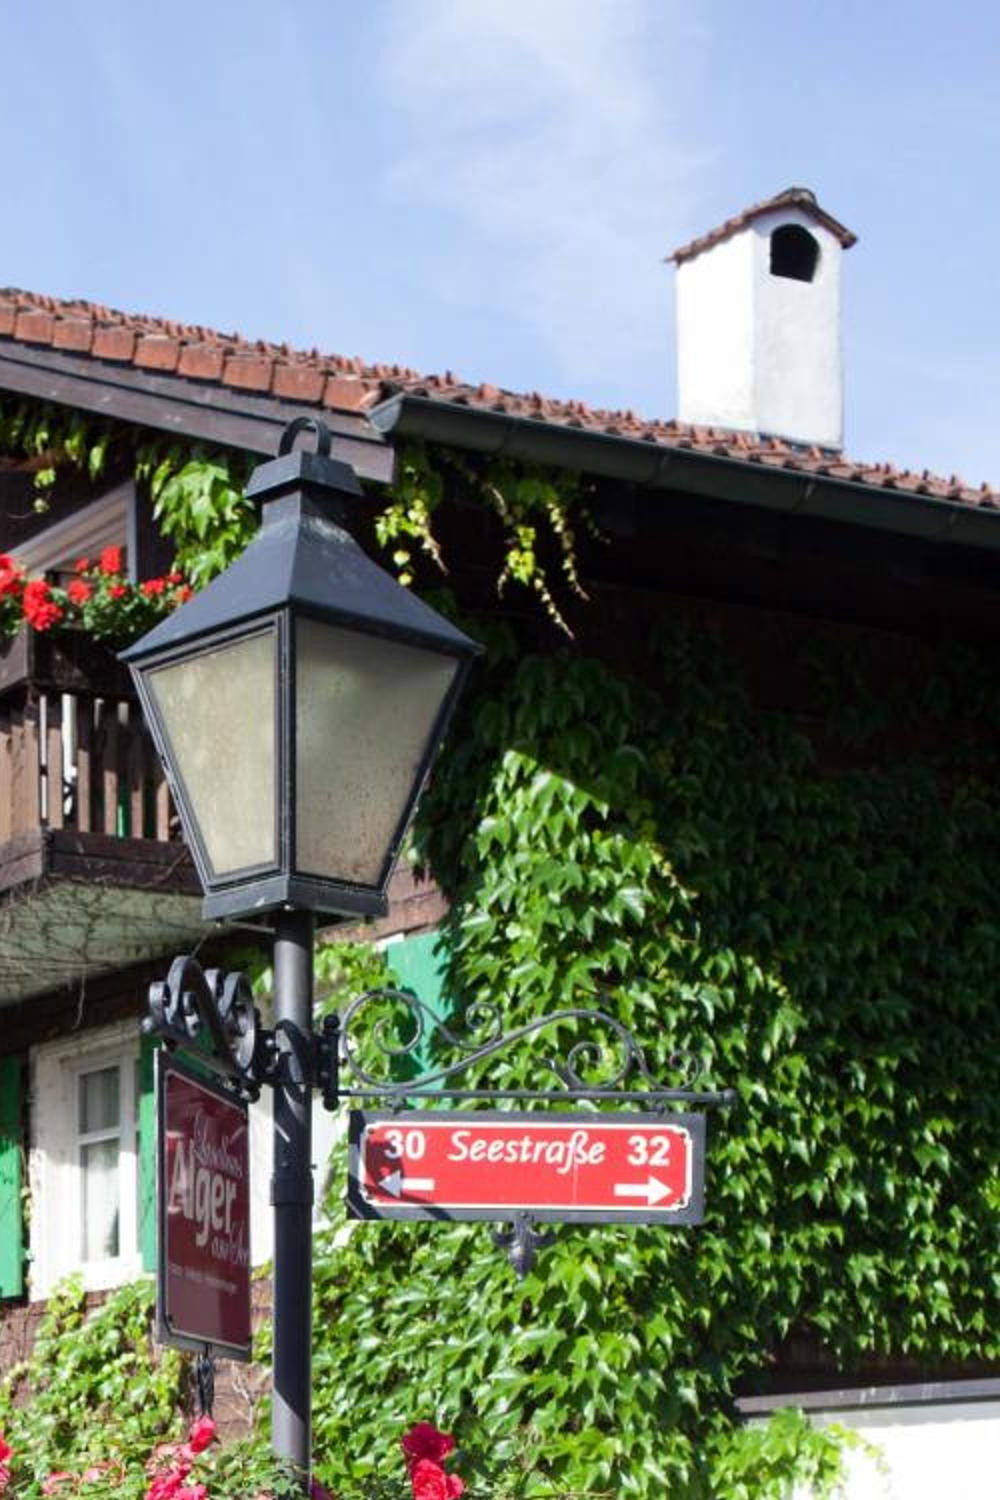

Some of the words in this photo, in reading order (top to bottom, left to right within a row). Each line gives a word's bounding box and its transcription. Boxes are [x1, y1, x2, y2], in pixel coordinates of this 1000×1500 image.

[384, 1129, 426, 1160] 30
[447, 1130, 607, 1175] Seestraße
[626, 1135, 671, 1167] 32
[169, 1138, 237, 1248] Alger
